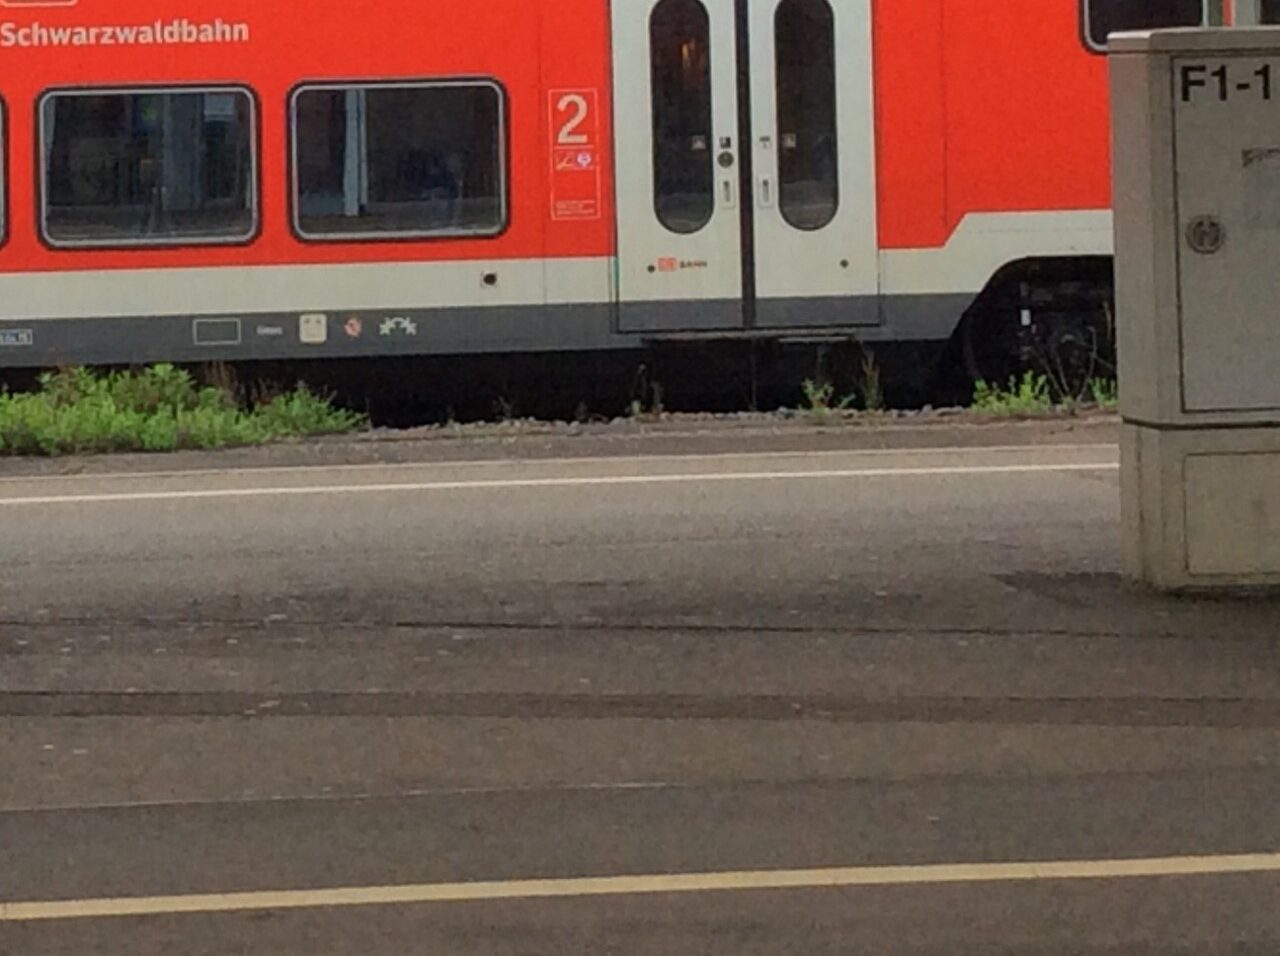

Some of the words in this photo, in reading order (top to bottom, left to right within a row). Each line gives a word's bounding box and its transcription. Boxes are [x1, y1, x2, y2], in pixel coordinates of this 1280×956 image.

[0, 18, 249, 47] Schwarzwaldbahn
[1181, 64, 1270, 102] F1-1
[557, 94, 588, 144] 2
